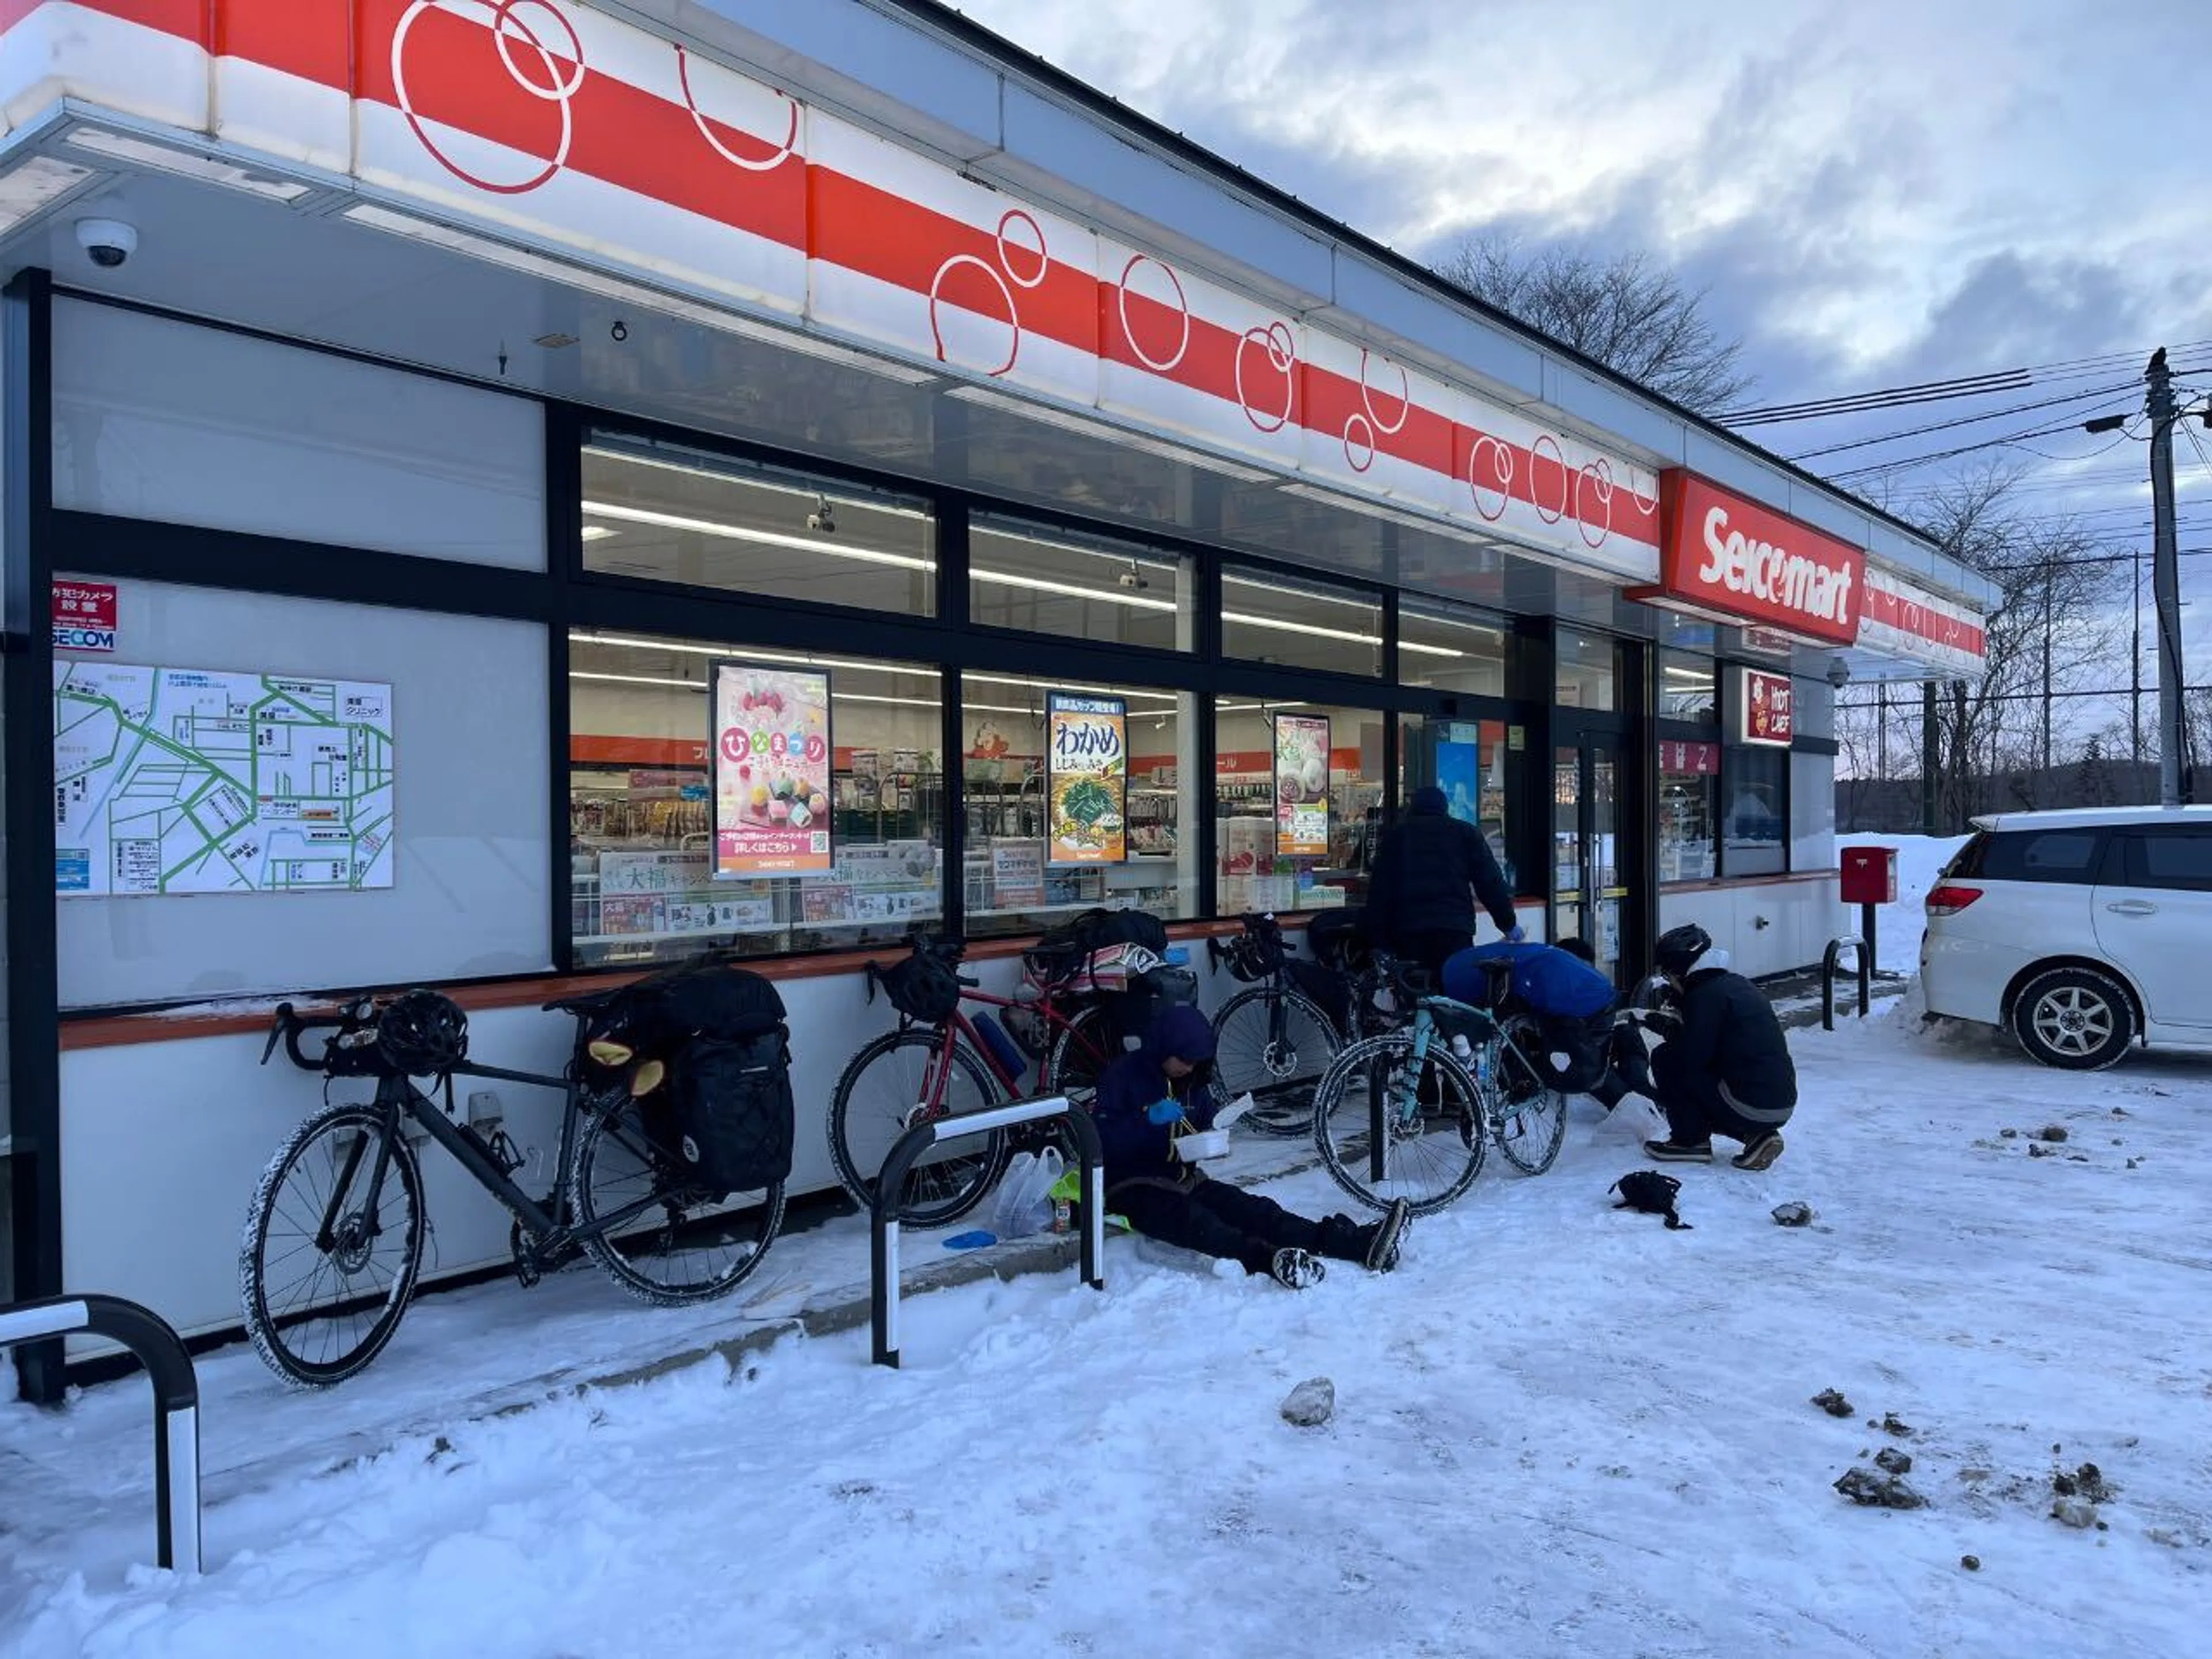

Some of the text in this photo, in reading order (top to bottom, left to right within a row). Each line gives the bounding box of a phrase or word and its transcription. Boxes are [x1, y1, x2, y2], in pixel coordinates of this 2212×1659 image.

[1700, 506, 1851, 624] Seicomart
[1771, 685, 1790, 712] HOT
[724, 734, 822, 759] ひなまつり
[1055, 721, 1119, 757] わかめ
